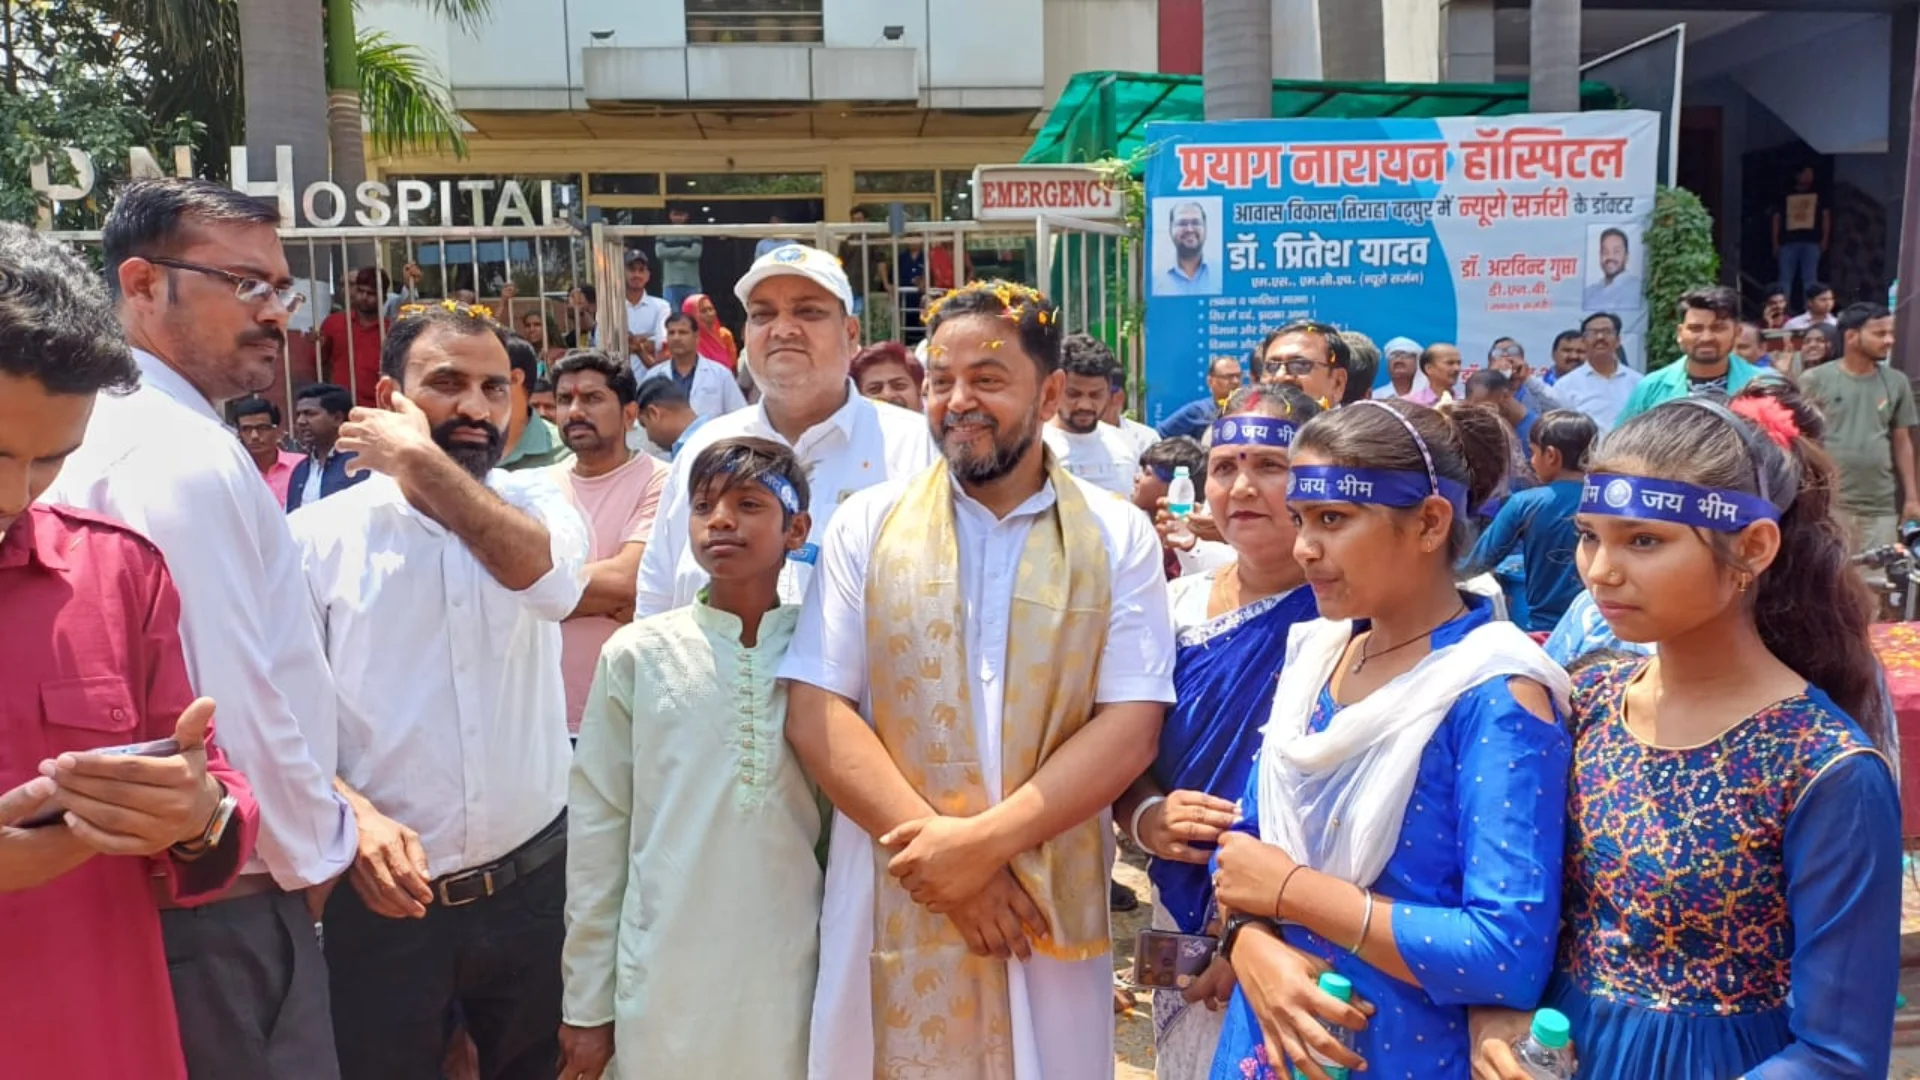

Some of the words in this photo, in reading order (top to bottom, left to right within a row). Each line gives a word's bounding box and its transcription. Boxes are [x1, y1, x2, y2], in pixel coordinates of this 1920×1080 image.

[1177, 145, 1282, 188] प्रयाग
[1289, 141, 1448, 184] नारायन
[1459, 127, 1629, 181] हॉस्पिटल
[982, 179, 1115, 207] EMERGENCY
[1234, 203, 1283, 222] आवास
[1288, 199, 1337, 221] विकास
[1341, 197, 1387, 220] तिराहा
[1435, 194, 1454, 217] में
[1458, 190, 1507, 227] न्यूरो
[1511, 188, 1569, 217] सर्जरी
[1572, 194, 1588, 215] के
[1591, 192, 1635, 214] डॉक्टर
[1227, 233, 1266, 271] डॉ.
[1274, 231, 1354, 270] प्रितेश
[1357, 237, 1430, 267] यादव
[1461, 255, 1481, 278] डॉ.
[1487, 254, 1547, 277] अरविन्द
[1241, 424, 1268, 439] जय
[1277, 426, 1297, 443] भी
[1300, 478, 1326, 495] जय
[1336, 474, 1373, 498] भीम
[1640, 488, 1685, 513] जय
[1697, 493, 1738, 522] भीम
